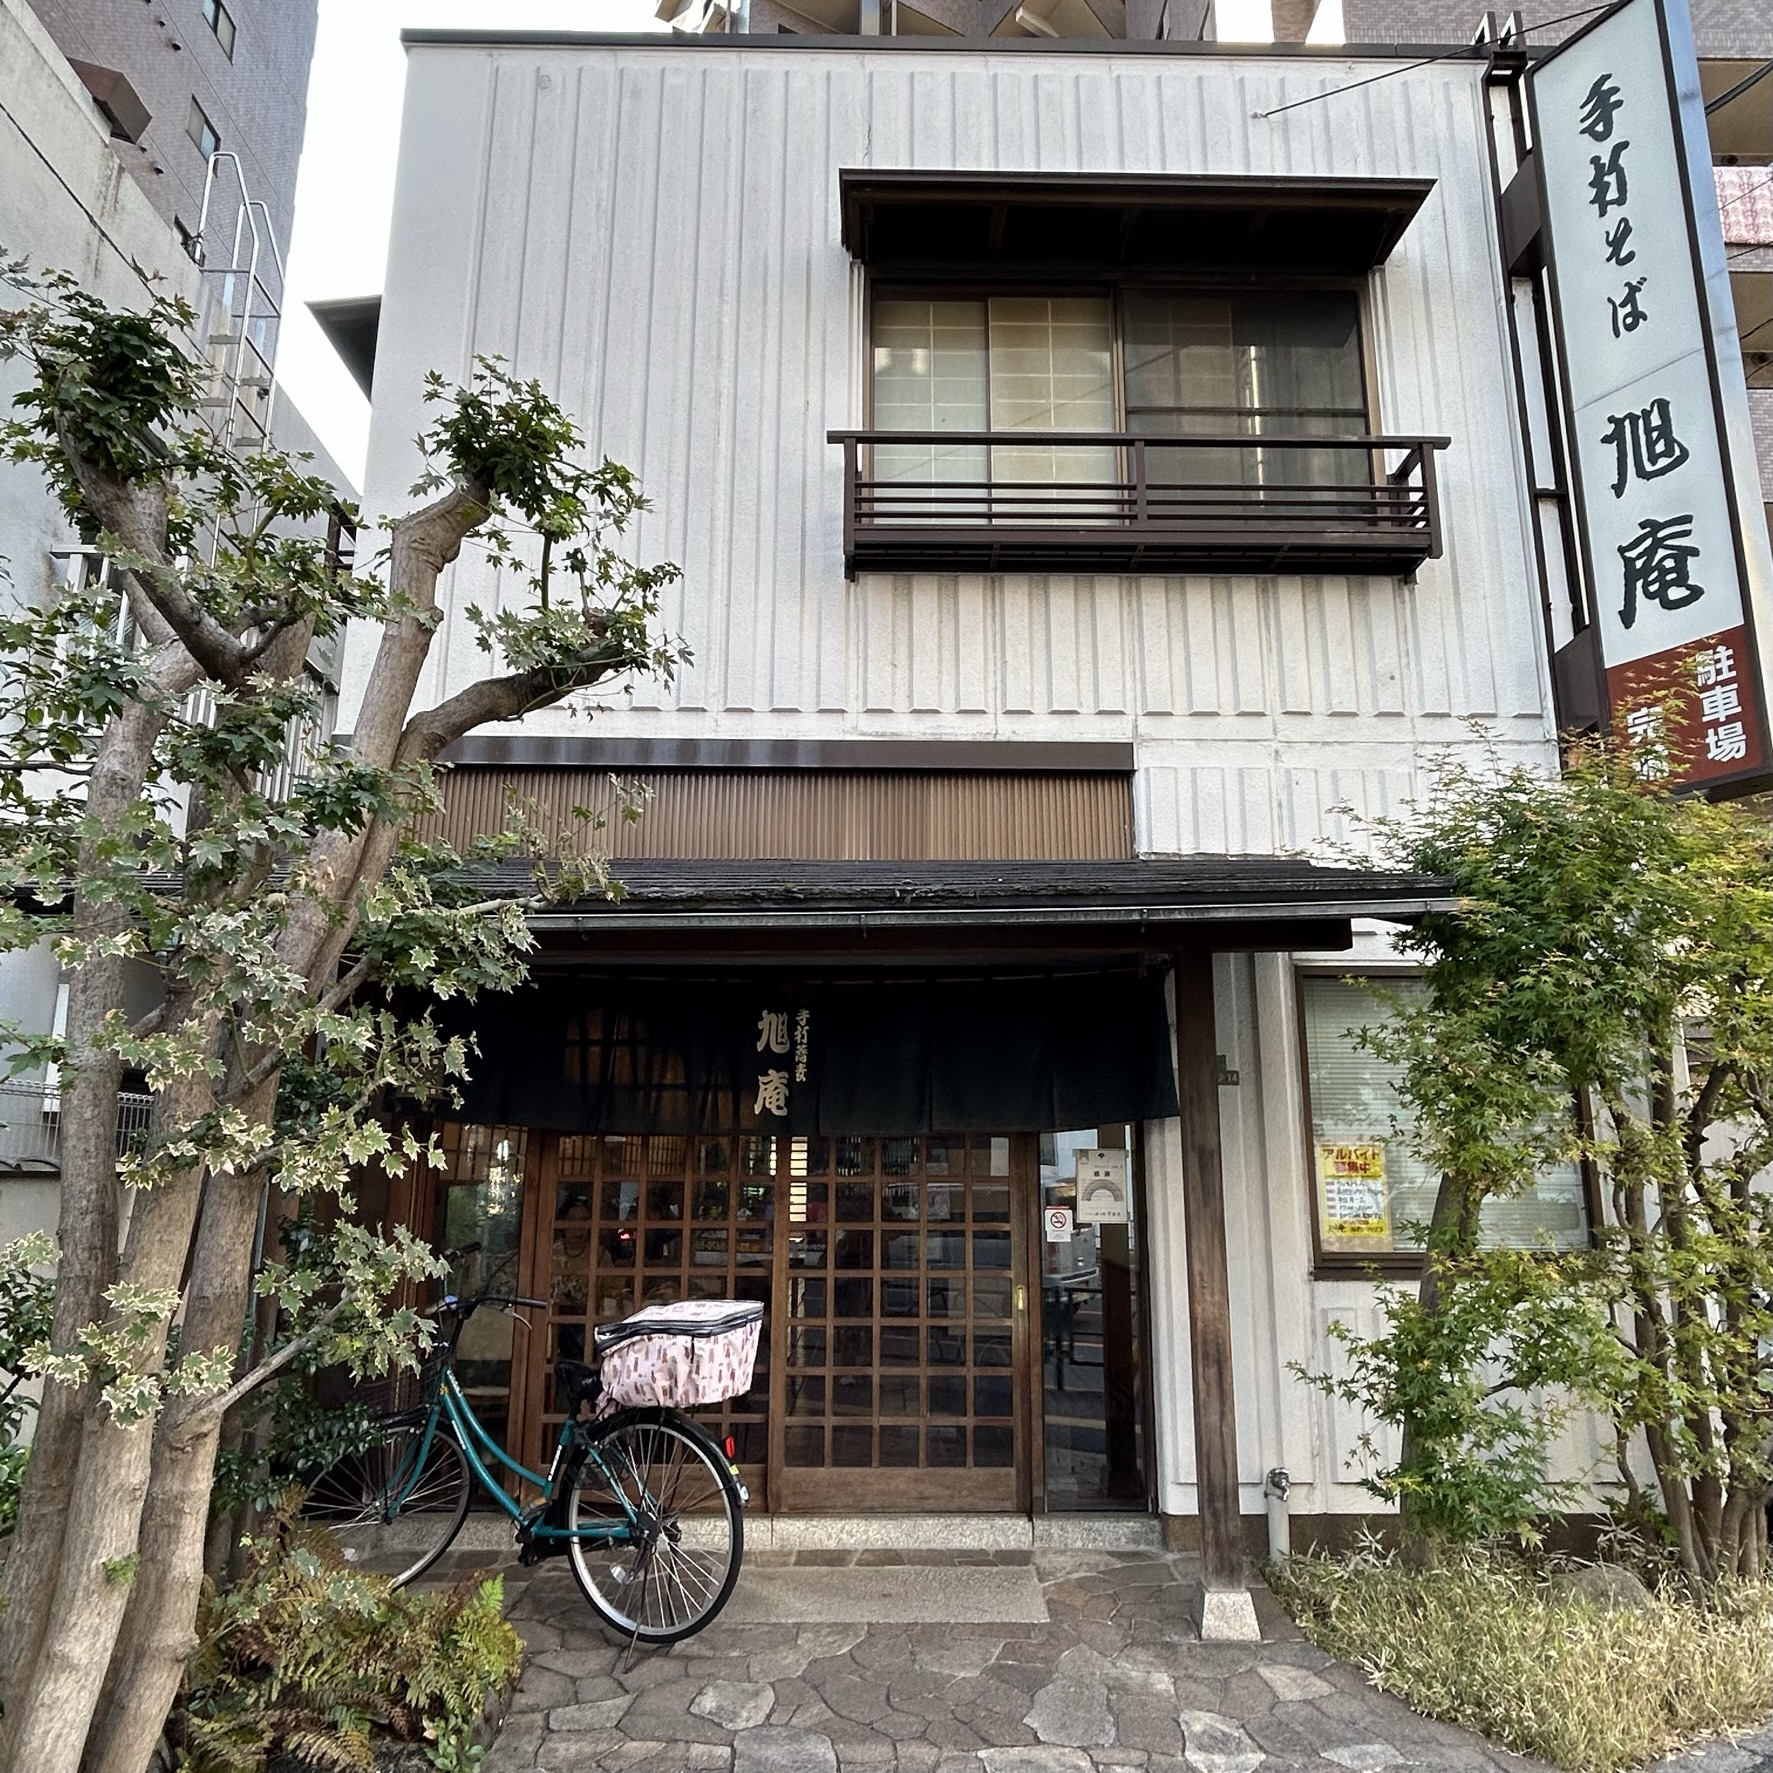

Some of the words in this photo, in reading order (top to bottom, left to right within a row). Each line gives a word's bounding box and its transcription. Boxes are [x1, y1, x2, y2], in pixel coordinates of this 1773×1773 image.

[1579, 73, 1648, 338] 手打そば
[1601, 398, 1704, 630] 旭庵
[1696, 645, 1747, 763] 駐車場
[754, 1009, 790, 1116] 旭庵
[1322, 1147, 1380, 1160] アルバイト
